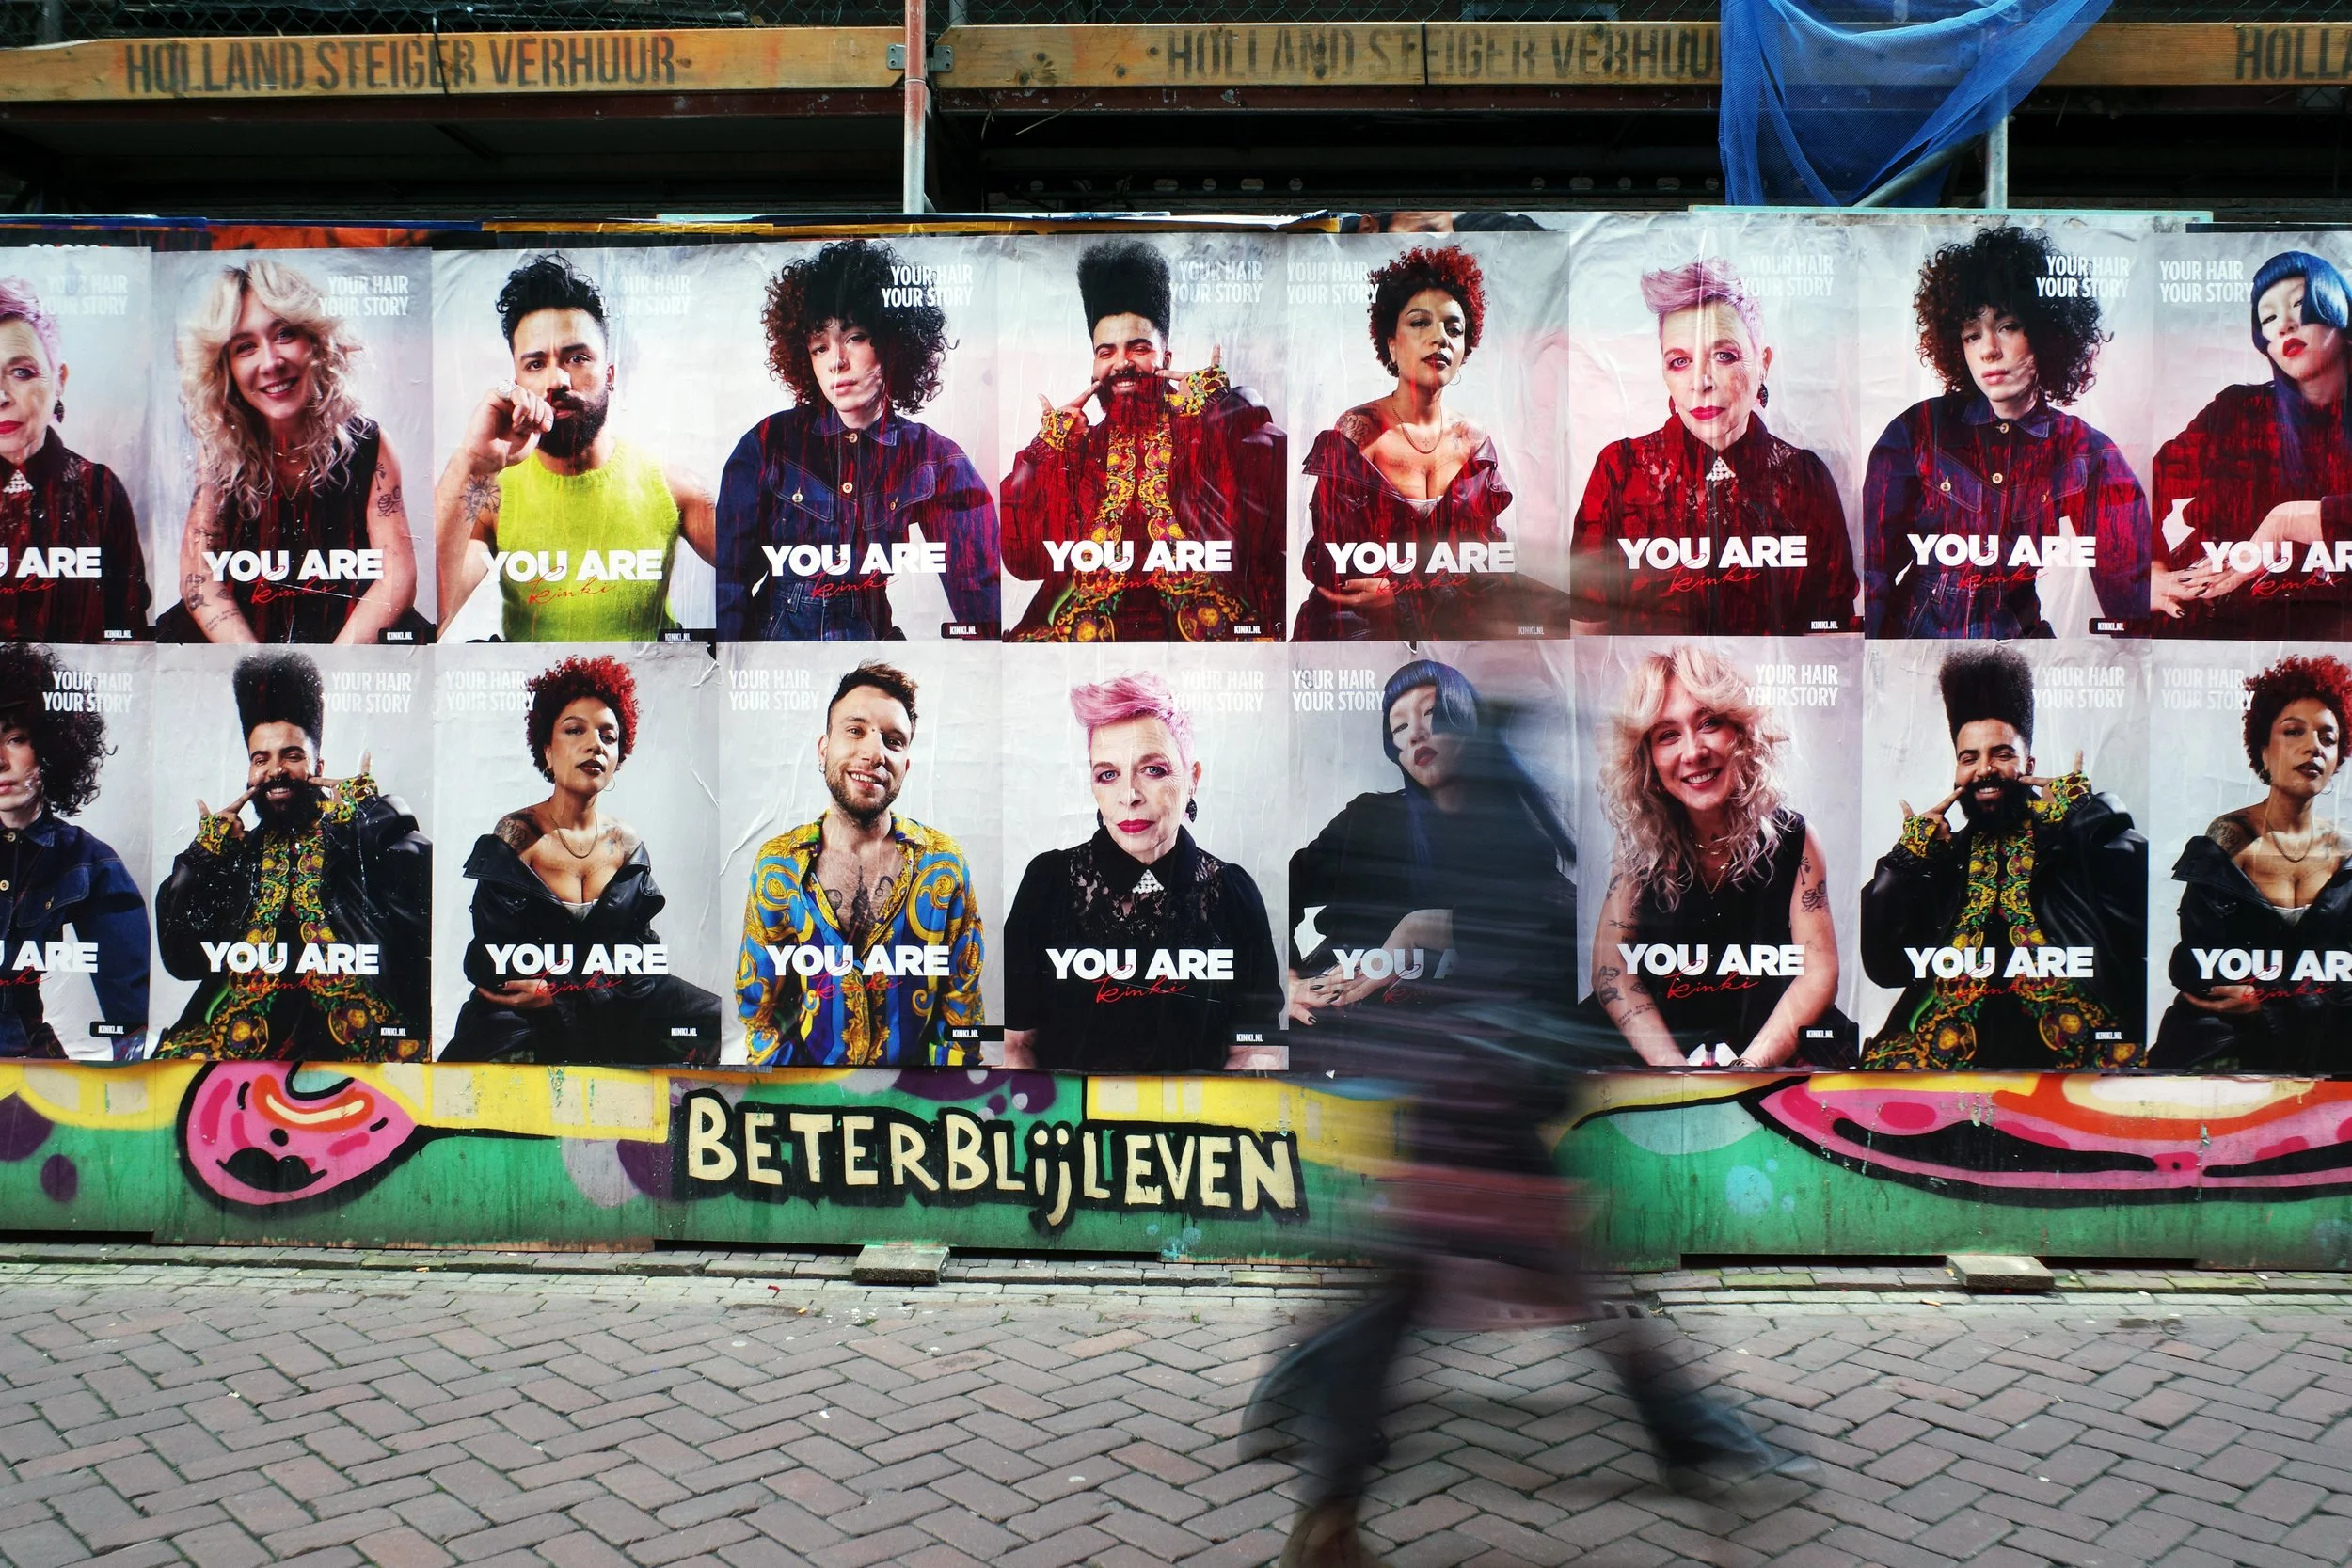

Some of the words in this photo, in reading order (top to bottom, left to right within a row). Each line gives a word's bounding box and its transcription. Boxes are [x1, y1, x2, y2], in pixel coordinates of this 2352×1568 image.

[1167, 28, 1355, 79] HOLLAND
[1368, 27, 1536, 78] STEIGER
[1552, 28, 1721, 78] VERHUU
[126, 40, 304, 93] HOLLAND
[315, 40, 477, 90] STEIGER
[890, 265, 932, 285] YOUR
[936, 264, 973, 284] HAIR
[1179, 261, 1220, 281] YOUR
[1225, 261, 1263, 281] HAIR
[1286, 261, 1327, 281] YOUR
[1331, 261, 1369, 282] HAIR
[1750, 254, 1791, 275] YOUR
[1797, 254, 1834, 275] HAIR
[2046, 256, 2089, 276] YOUR
[2092, 256, 2130, 276] HAIR
[2160, 261, 2201, 281] YOUR
[2206, 261, 2244, 281] HAIR
[91, 275, 128, 293] HAIR
[327, 276, 369, 294] YOUR
[373, 275, 409, 294] HAIR
[654, 274, 691, 294] HAIR
[1169, 284, 1211, 303] YOUR
[1215, 283, 1263, 303] STORY
[1286, 284, 1328, 304] YOUR
[1332, 284, 1379, 304] STORY
[1740, 277, 1783, 297] YOUR
[1788, 277, 1834, 296] STORY
[2036, 277, 2078, 297] YOUR
[2081, 277, 2129, 297] STORY
[2160, 283, 2202, 303] YOUR
[2206, 283, 2254, 303] STORY
[82, 296, 128, 315] STORY
[318, 297, 359, 316] YOUR
[363, 296, 409, 316] STORY
[645, 295, 691, 315] STORY
[881, 287, 923, 308] YOUR
[927, 286, 973, 307] STORY
[762, 544, 850, 577] YOU
[859, 542, 946, 575] ARE
[1042, 540, 1135, 572] YOU
[1142, 541, 1232, 572] ARE
[1325, 541, 1417, 575] YOU
[1424, 542, 1515, 573] ARE
[1617, 537, 1710, 570] YOU
[1718, 535, 1807, 568] ARE
[1907, 533, 1999, 566] YOU
[2007, 535, 2096, 568] ARE
[2201, 541, 2293, 573] YOU
[2301, 540, 2352, 573] AR
[15, 547, 102, 578] ARE
[202, 550, 290, 581] YOU
[297, 549, 384, 580] ARE
[481, 550, 567, 582] YOU
[576, 549, 662, 580] ARE
[949, 626, 977, 635] KINKI.NL
[1233, 626, 1261, 634] KINKI.NL
[1518, 626, 1544, 635] KINKI.NL
[1811, 621, 1838, 629] KINKI.NL
[2097, 623, 2124, 631] KINKI.NL
[387, 631, 413, 641] KINKI.NL
[53, 671, 92, 690] YOUR
[97, 673, 133, 691] HAIR
[332, 671, 372, 690] YOUR
[376, 672, 412, 691] HAIR
[445, 671, 485, 689] YOUR
[490, 671, 527, 690] HAIR
[729, 669, 770, 689] YOUR
[773, 669, 810, 689] HAIR
[1181, 670, 1222, 689] YOUR
[1227, 670, 1263, 690] HAIR
[1292, 670, 1334, 689] YOUR
[1338, 669, 1375, 689] HAIR
[1756, 664, 1796, 685] YOUR
[1801, 664, 1838, 685] HAIR
[2043, 667, 2084, 687] YOUR
[2089, 666, 2125, 687] HAIR
[2163, 668, 2203, 688] YOUR
[2207, 668, 2245, 689] HAIR
[42, 692, 84, 712] YOUR
[87, 693, 133, 712] STORY
[322, 693, 362, 712] YOUR
[366, 693, 411, 713] STORY
[446, 691, 486, 711] YOUR
[490, 691, 536, 711] STORY
[729, 691, 770, 711] YOUR
[773, 690, 819, 711] STORY
[1172, 692, 1214, 712] YOUR
[1217, 691, 1263, 712] STORY
[1292, 691, 1334, 711] YOUR
[1338, 691, 1385, 712] STORY
[1745, 687, 1787, 706] YOUR
[1790, 687, 1838, 706] STORY
[2033, 689, 2074, 708] YOUR
[2078, 689, 2125, 708] STORY
[2161, 689, 2202, 709] YOUR
[2207, 690, 2255, 711] STORY
[12, 941, 98, 973] ARE
[200, 942, 288, 974] YOU
[295, 942, 379, 974] ARE
[485, 943, 574, 975] YOU
[581, 943, 668, 975] ARE
[766, 944, 852, 976] YOU
[862, 945, 949, 976] ARE
[1045, 948, 1136, 980] YOU
[1144, 948, 1234, 980] ARE
[1332, 948, 1424, 980] YOU
[1616, 943, 1708, 975] YOU
[1715, 944, 1804, 975] ARE
[1904, 947, 1995, 978] YOU
[2003, 947, 2094, 977] ARE
[2191, 948, 2283, 981] YOU
[2290, 950, 2352, 982] AR
[98, 1025, 124, 1035] KINKI.NL
[380, 1027, 406, 1037] KINKI.NL
[671, 1027, 697, 1037] KINKI.NL
[952, 1029, 979, 1038] KINKI.NL
[1236, 1033, 1263, 1042] KINKI.NL
